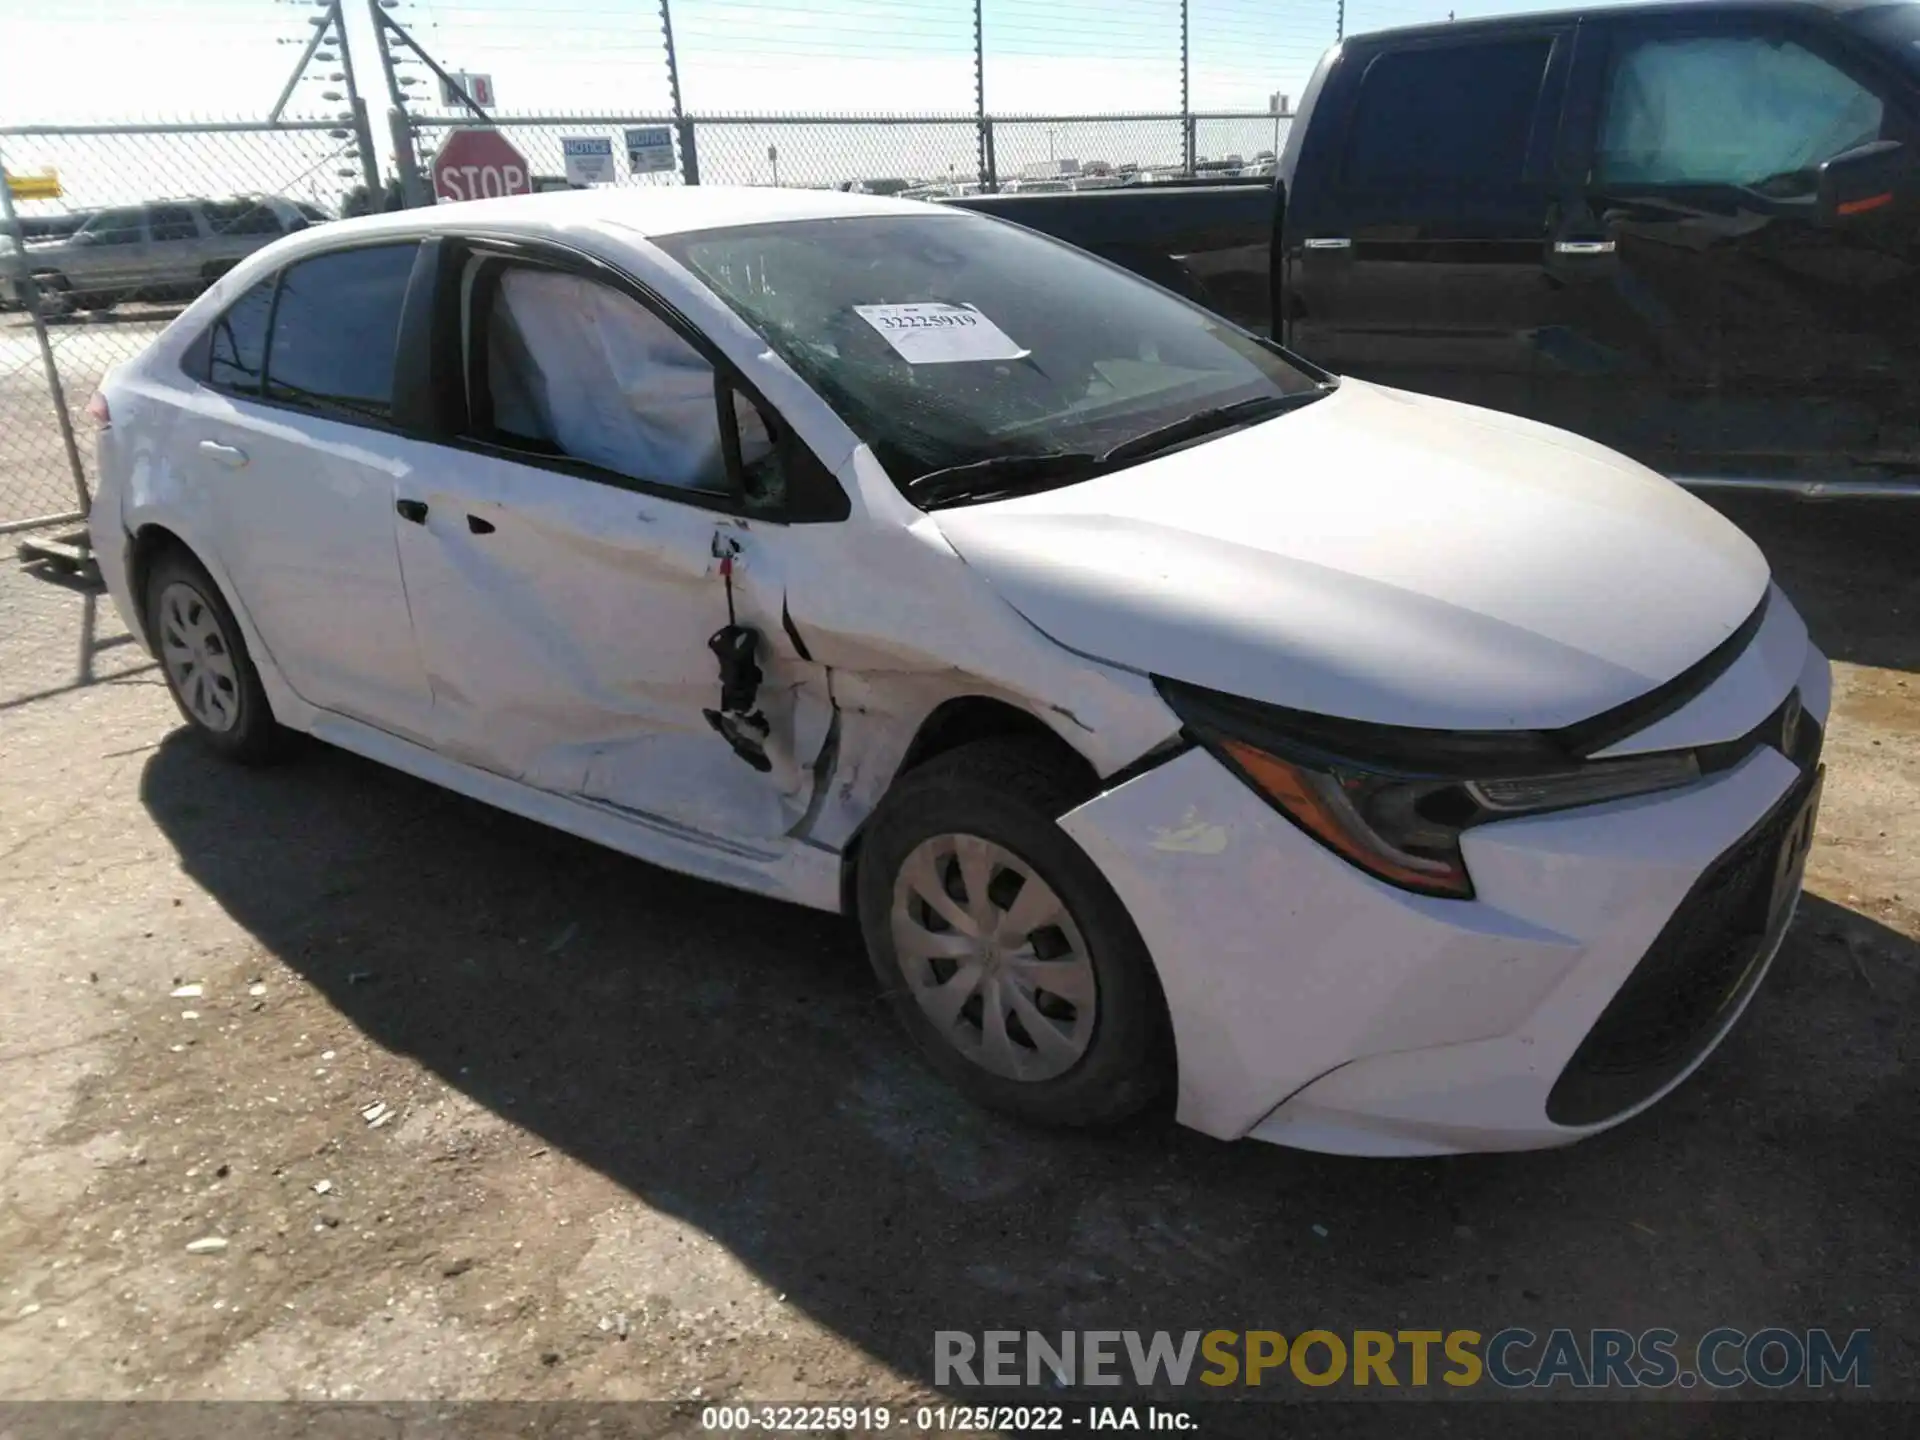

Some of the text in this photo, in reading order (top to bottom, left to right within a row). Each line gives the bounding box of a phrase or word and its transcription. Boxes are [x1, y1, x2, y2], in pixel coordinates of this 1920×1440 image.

[566, 140, 609, 154] NOTICE
[442, 165, 523, 201] STOP
[879, 315, 977, 329] 32225919
